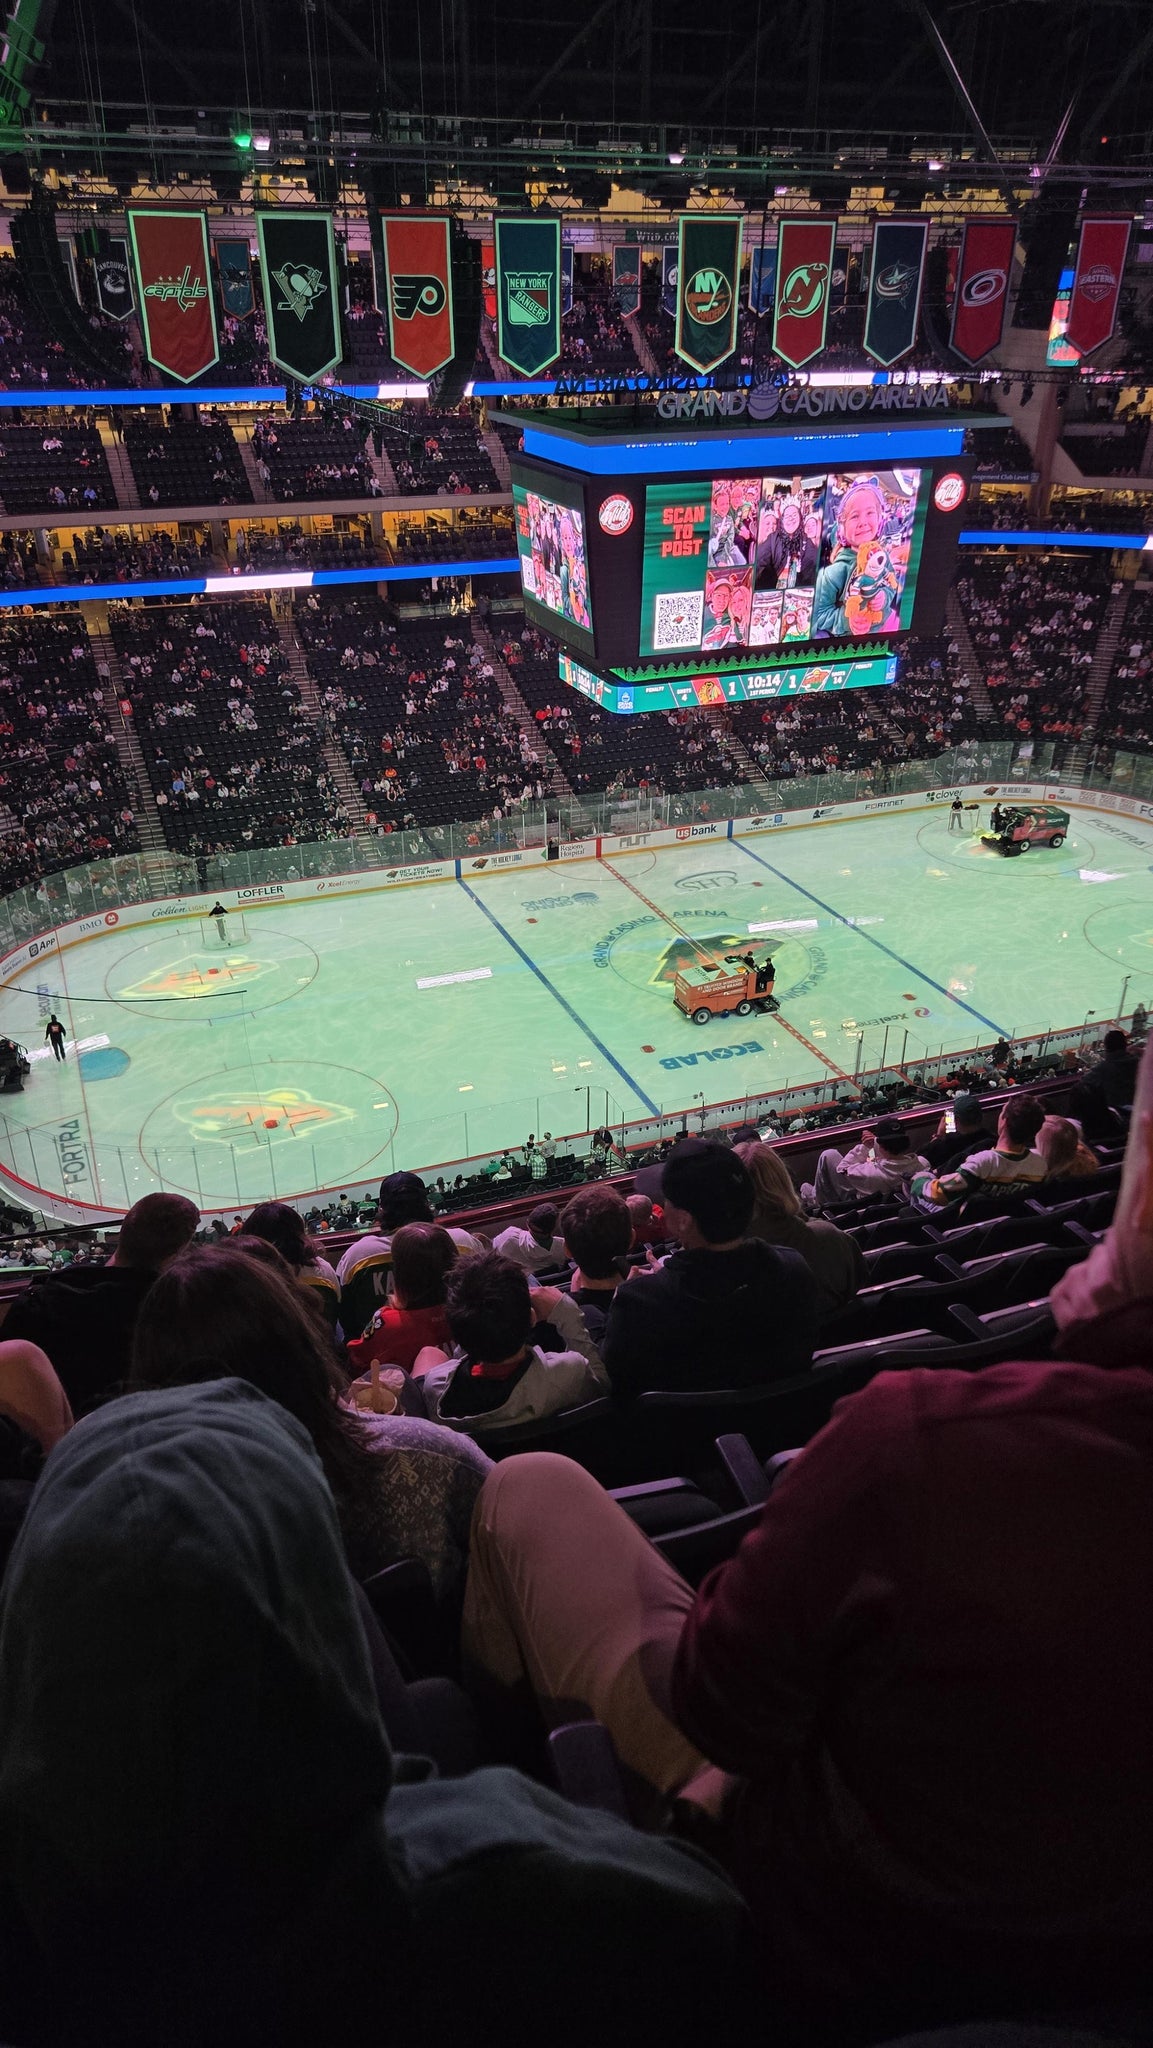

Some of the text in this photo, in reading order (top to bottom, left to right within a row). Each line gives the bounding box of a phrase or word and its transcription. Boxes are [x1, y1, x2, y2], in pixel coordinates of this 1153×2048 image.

[510, 278, 547, 288] NEW YORK
[1081, 274, 1115, 284] EASTERN
[515, 291, 547, 321] RANGERS
[657, 384, 949, 419] GRAND CASINO ARENA
[663, 506, 705, 524] SCAN
[674, 524, 694, 540] TO
[661, 539, 702, 557] POST
[747, 673, 782, 689] 10:14
[788, 674, 797, 689] 1
[832, 676, 843, 685] 14
[728, 681, 737, 697] 1
[681, 694, 688, 702] 4
[936, 789, 964, 800] clover
[865, 799, 904, 810] FORTINET
[692, 823, 717, 836] bank
[1086, 818, 1148, 846] FORTRA
[560, 844, 584, 853] Regions
[560, 848, 585, 858] Hospital
[237, 885, 284, 899] LOFFLER
[152, 904, 209, 918] Golden LIGHT
[79, 918, 102, 933] BMO
[592, 909, 729, 969] GRAND CASINO ARENA
[779, 946, 829, 1003] GRAND CASIN
[880, 1012, 909, 1024] Xcel
[660, 1040, 765, 1071] ECOLAB
[58, 1119, 88, 1186] FORTRA
